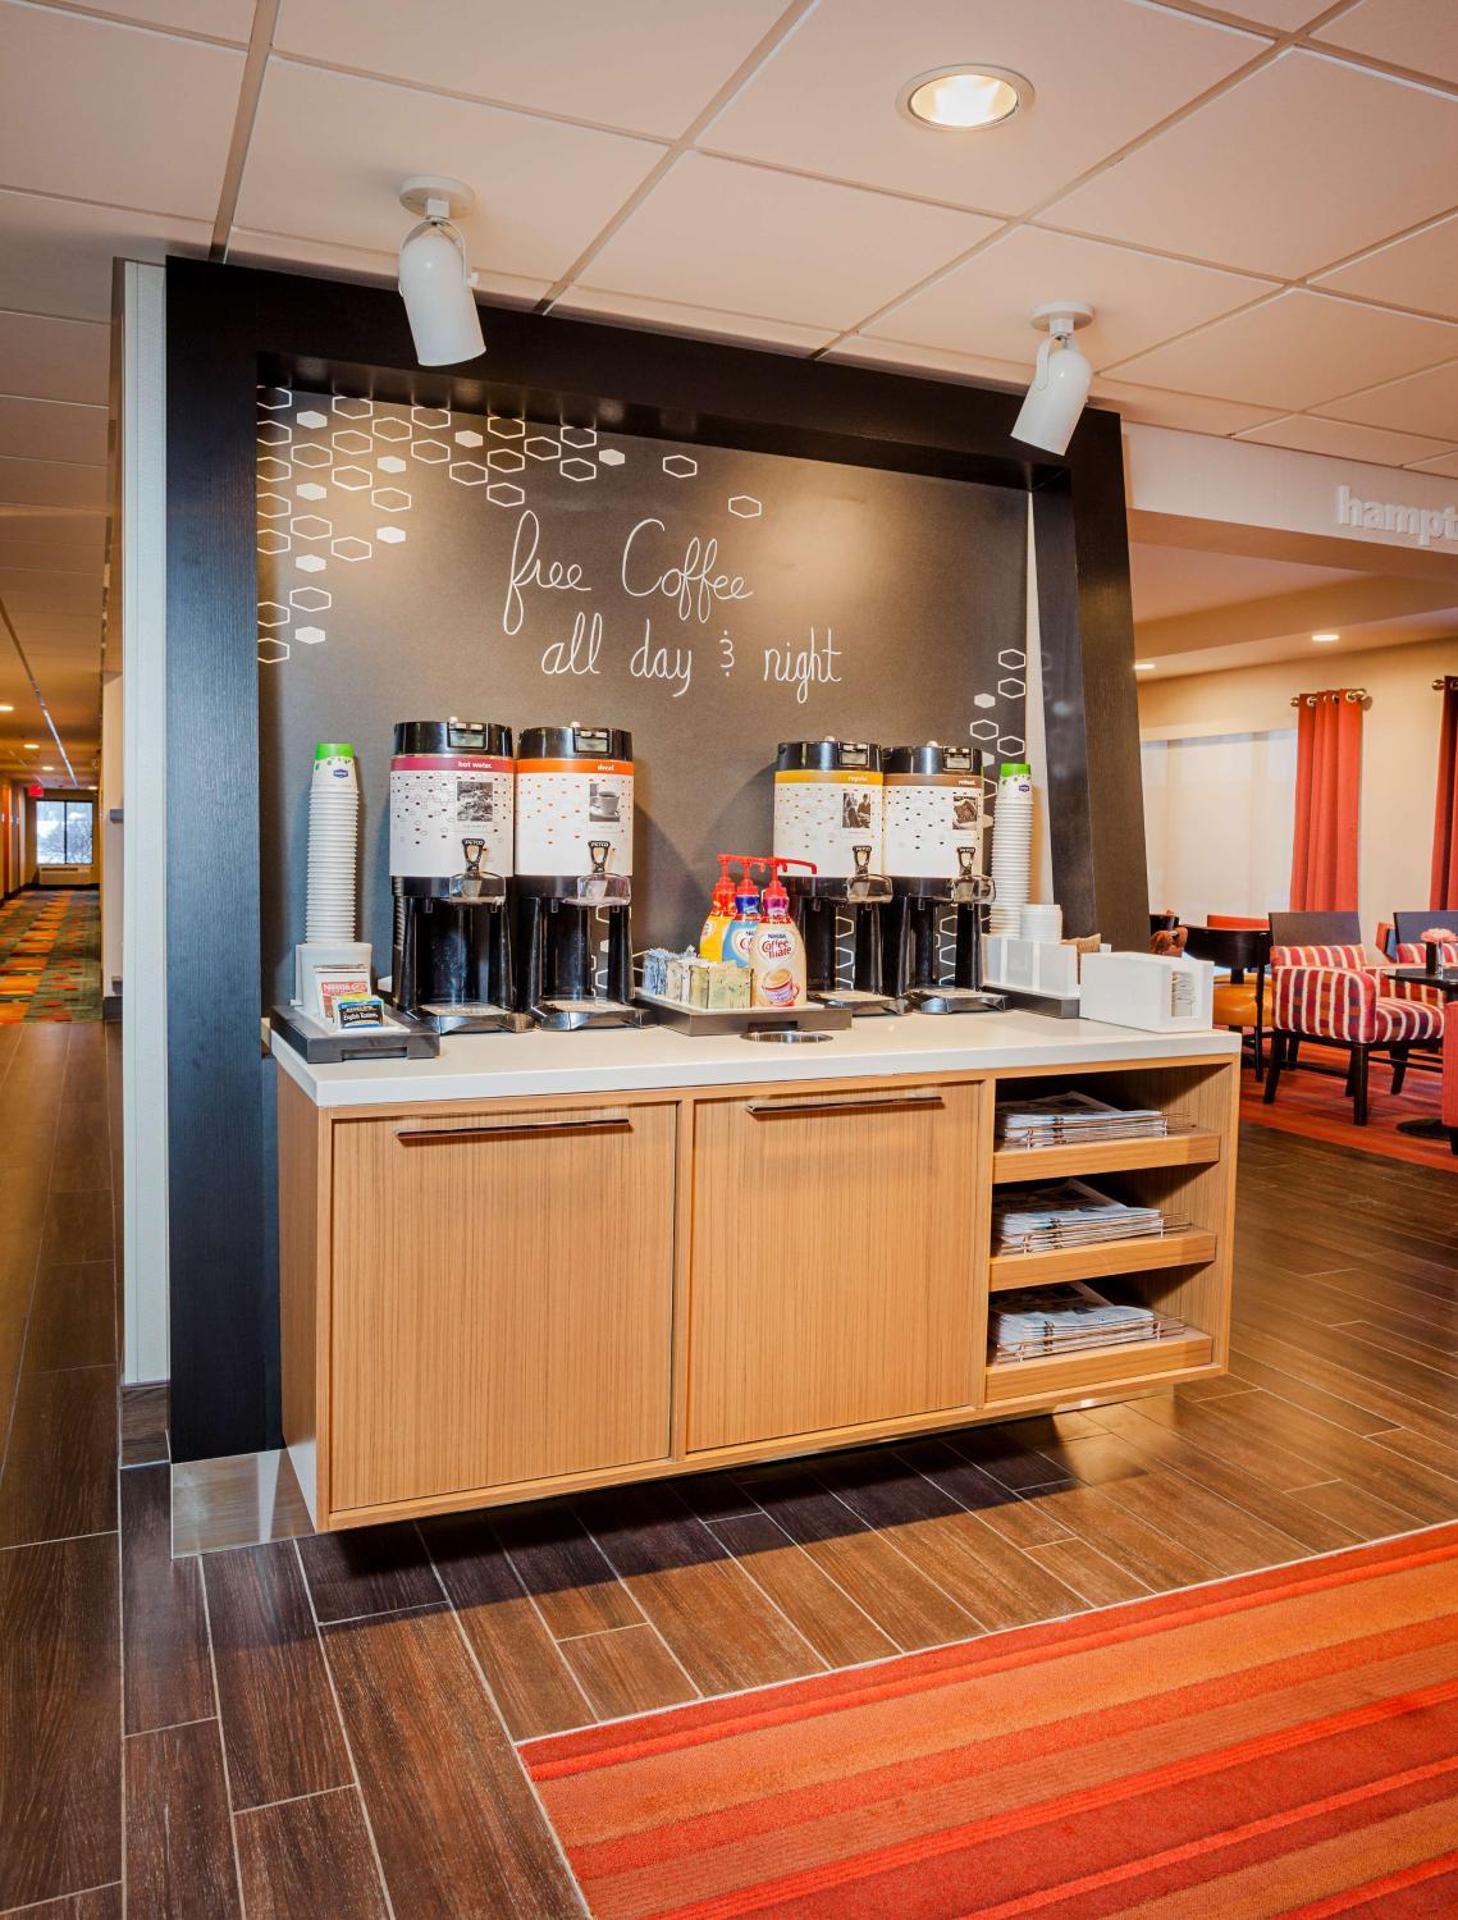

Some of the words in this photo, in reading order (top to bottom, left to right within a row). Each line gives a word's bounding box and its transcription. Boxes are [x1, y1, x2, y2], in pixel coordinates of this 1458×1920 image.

[503, 510, 592, 635] free
[622, 518, 753, 623] Coffee
[541, 612, 602, 674] all
[630, 619, 692, 697] day
[763, 628, 842, 704] night
